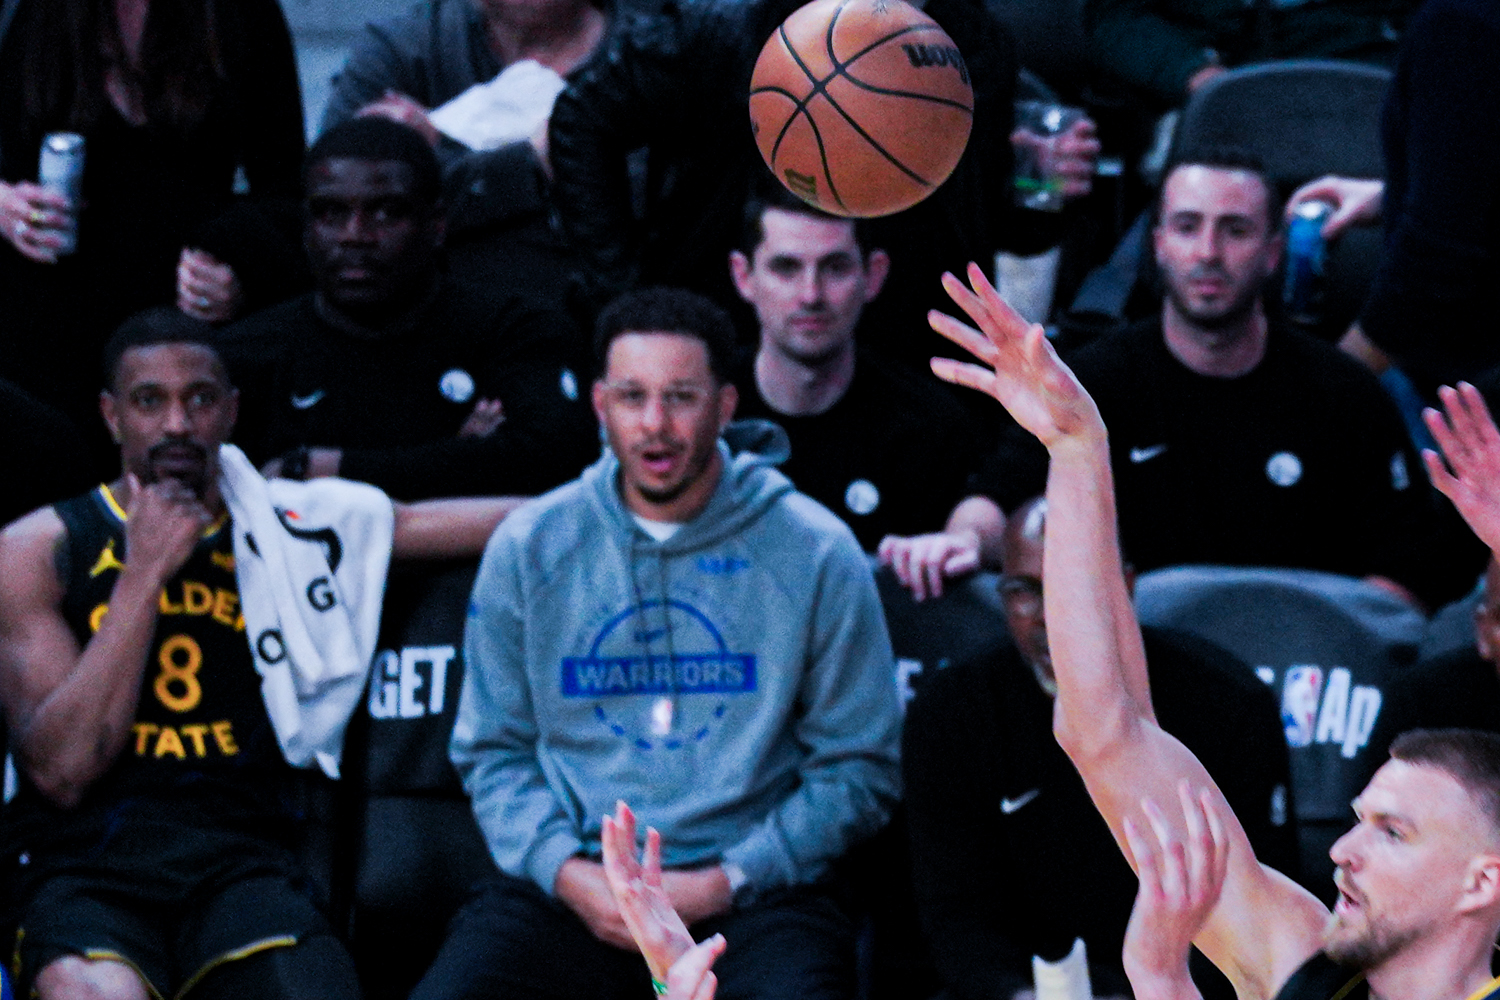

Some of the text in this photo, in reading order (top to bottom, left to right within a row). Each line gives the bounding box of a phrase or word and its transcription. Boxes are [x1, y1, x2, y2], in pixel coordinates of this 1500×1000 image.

[153, 633, 203, 713] 8
[368, 644, 456, 719] GET
[574, 659, 746, 692] WARRIORS
[131, 719, 240, 760] TATE
[1315, 665, 1383, 759] Ap
